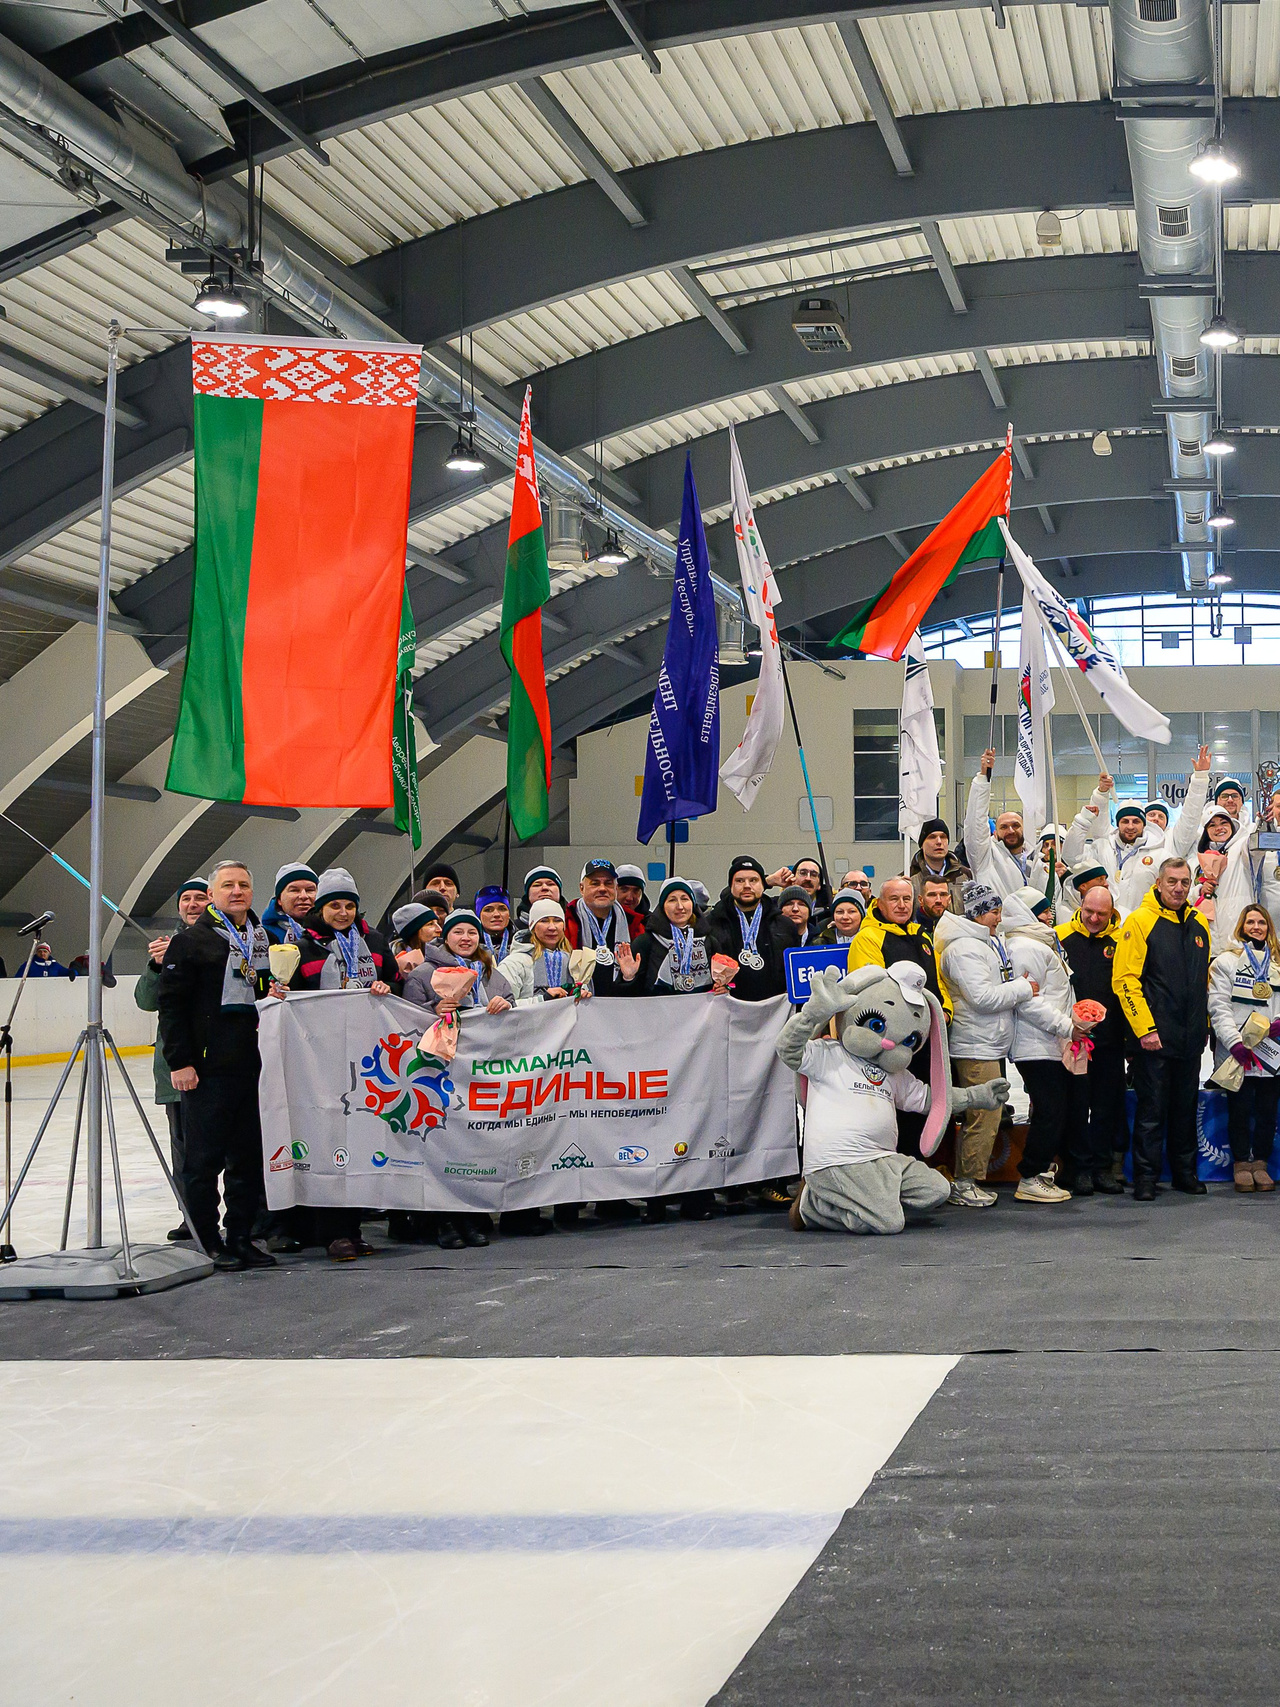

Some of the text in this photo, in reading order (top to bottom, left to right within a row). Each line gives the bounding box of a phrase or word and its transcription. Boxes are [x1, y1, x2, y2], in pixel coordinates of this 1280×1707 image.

[658, 664, 678, 711] МЕНТ
[472, 1048, 592, 1075] КОМАНДА
[468, 1069, 668, 1118] ЕДИНЫЕ
[467, 1121, 502, 1131] КОГДА
[504, 1119, 523, 1129] МЫ
[526, 1112, 556, 1127] ЕДИНЫ
[569, 1109, 588, 1118] МЫ
[590, 1106, 667, 1119] НЕПОБЕДИМЫ!
[444, 1166, 497, 1176] ВОСТОЧНЫЙ
